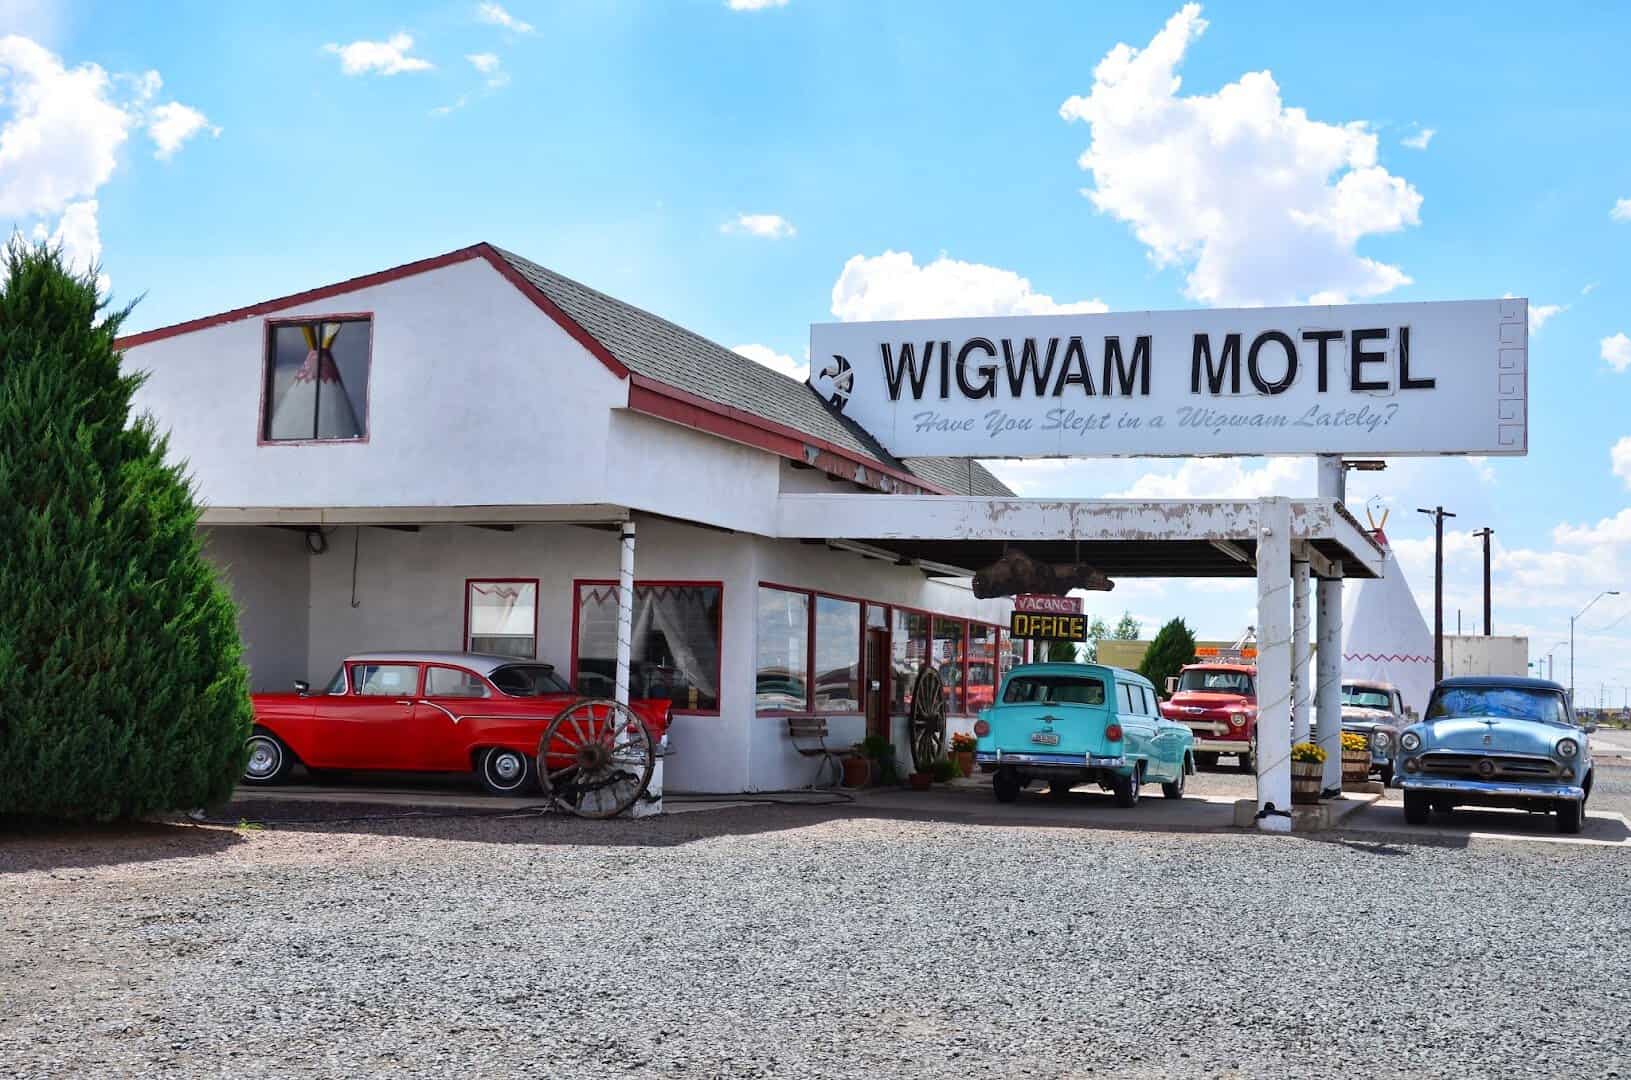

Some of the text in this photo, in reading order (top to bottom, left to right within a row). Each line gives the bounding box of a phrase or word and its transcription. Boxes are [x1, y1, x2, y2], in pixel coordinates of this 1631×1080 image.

[881, 326, 1436, 400] WIGWAM MOTEL
[912, 403, 1399, 438] Have You Slept in a Wigwam Lately?
[1018, 597, 1081, 611] VACANCY
[1014, 614, 1084, 639] OFFICE
